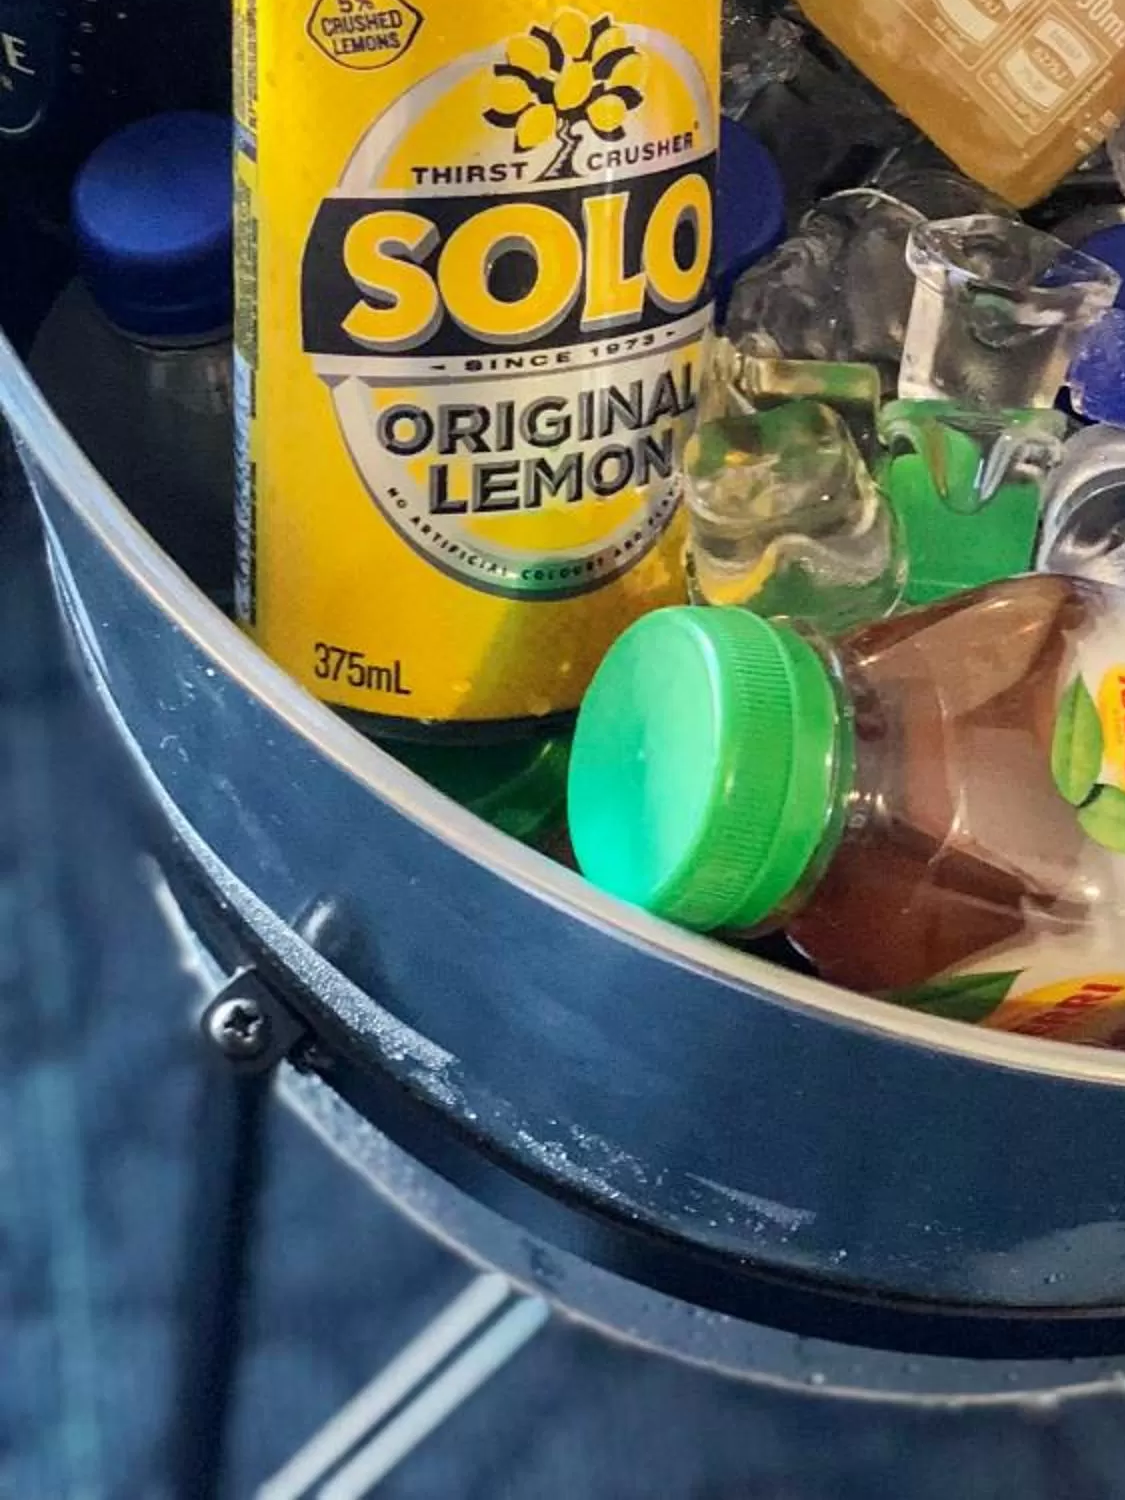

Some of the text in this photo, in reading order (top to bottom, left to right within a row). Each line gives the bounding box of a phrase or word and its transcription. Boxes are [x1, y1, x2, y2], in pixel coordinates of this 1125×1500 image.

[322, 10, 404, 35] CRUSHED
[331, 31, 402, 56] LEMONS
[411, 132, 696, 186] THIRST CRUSHER
[341, 172, 713, 352] SOLO
[464, 333, 656, 372] SINCE 1973
[377, 362, 698, 457] ORIGINAL
[428, 428, 674, 515] LEMON
[409, 515, 508, 578] ARTIFICIAL
[314, 641, 412, 695] 375mL
